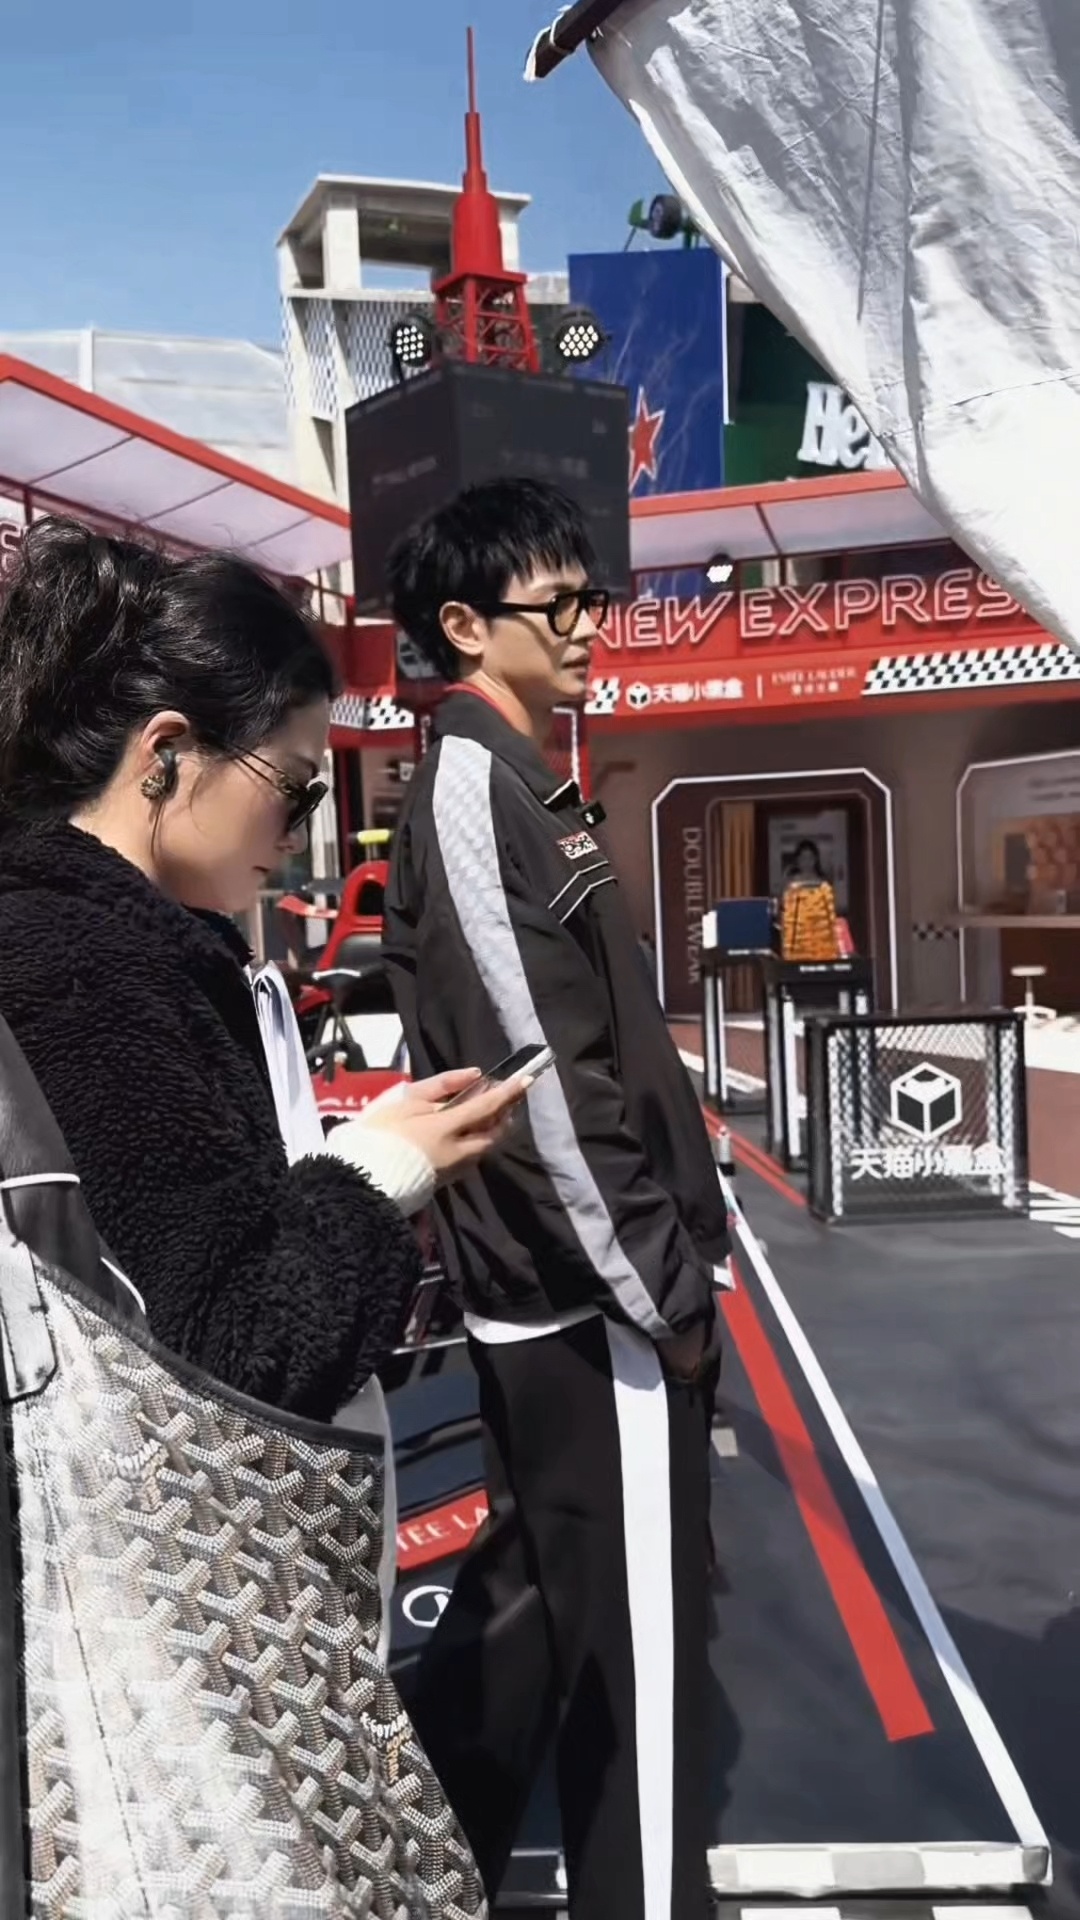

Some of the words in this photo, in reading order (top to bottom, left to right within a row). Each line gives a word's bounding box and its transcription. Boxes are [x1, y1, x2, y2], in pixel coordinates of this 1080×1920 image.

[598, 591, 735, 648] NEW
[740, 568, 1026, 639] EXPRES
[682, 827, 704, 913] DOUBLE
[687, 920, 703, 984] WEAR
